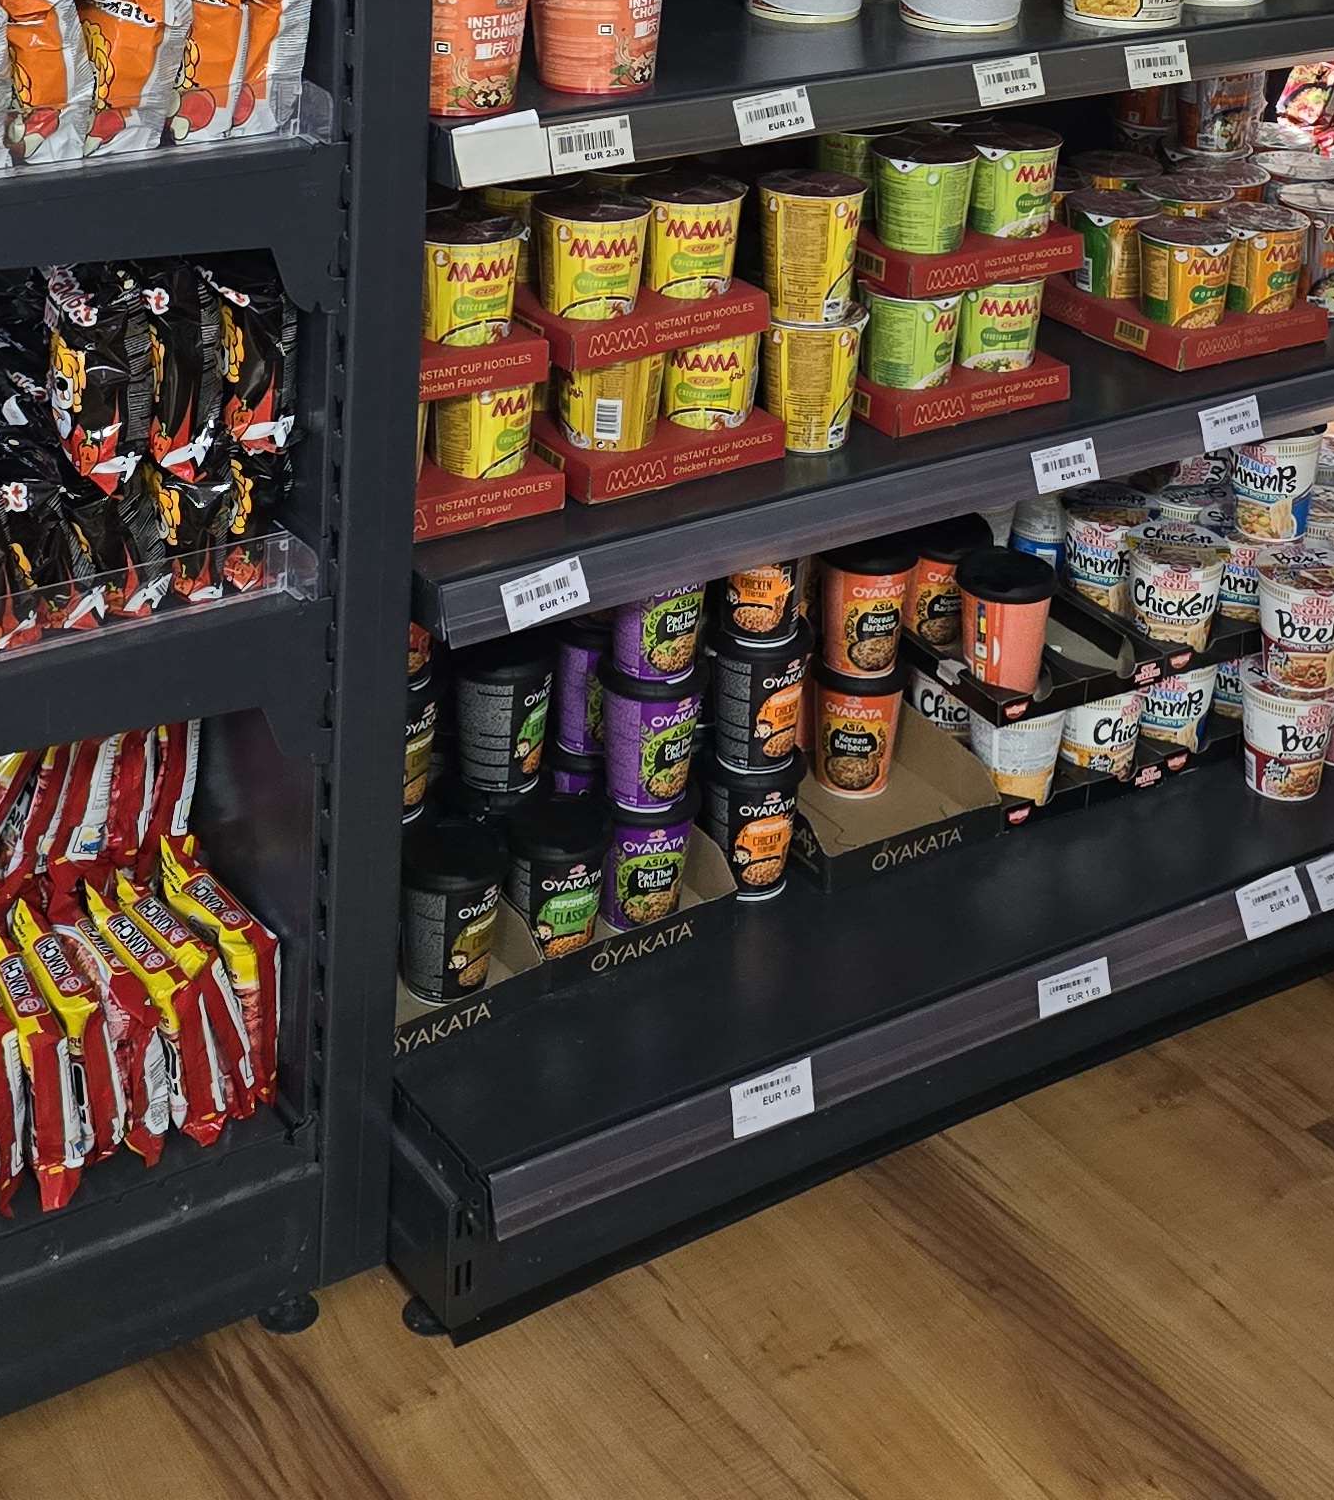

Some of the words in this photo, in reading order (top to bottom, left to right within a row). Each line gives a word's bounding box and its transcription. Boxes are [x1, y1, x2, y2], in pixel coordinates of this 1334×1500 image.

[1152, 72, 1168, 82] EUR
[1169, 68, 1184, 79] 2.79
[1004, 84, 1021, 96] EUR
[1022, 81, 1038, 93] 2.79
[768, 121, 788, 131] EUR
[584, 151, 604, 162] EUR
[606, 147, 626, 159] 2.39
[666, 217, 733, 241] MAMA
[568, 236, 639, 260] MAMA
[926, 261, 978, 291] MAMA
[1017, 251, 1033, 264] CUP
[1033, 244, 1074, 261] NOODLES
[984, 264, 1020, 279] Vegetable
[1022, 258, 1048, 273] Flavour
[587, 324, 650, 359] MAMA
[654, 315, 689, 331] INSTANT
[689, 312, 708, 325] CUP
[710, 302, 755, 322] NOODLES
[654, 328, 684, 344] Chicken
[686, 319, 722, 337] Flavour
[673, 447, 706, 464] INSTANT
[707, 442, 726, 455] CUP
[727, 432, 773, 452] NOODLES
[1060, 471, 1076, 482] EUR
[1079, 466, 1093, 478] 1.79
[435, 499, 476, 514] INSTANT
[479, 492, 499, 506] CUP
[501, 481, 552, 501] NOODLES
[435, 510, 474, 527] Chicken
[477, 502, 512, 519] Flavour
[852, 580, 908, 599] OYAKATA
[1153, 578, 1199, 591] NOODLES
[538, 599, 556, 613] EUR
[559, 590, 579, 607] 1.79
[861, 620, 897, 634] Barbecue
[866, 615, 895, 627] Korean
[825, 705, 883, 720] OYAKATA
[841, 722, 866, 733] ASIA
[833, 740, 873, 753] Barbecue
[836, 734, 869, 745] Korean
[738, 796, 796, 819] OYAKATA
[622, 835, 685, 854] OYAKATA
[752, 832, 783, 846] CHICKEN
[541, 867, 603, 894] OYAKATA
[636, 870, 653, 881] Pad
[654, 867, 673, 880] Thai
[636, 876, 672, 889] Chicken
[1270, 901, 1284, 912] EUR
[137, 896, 177, 942] KIMCHI
[589, 920, 693, 972] OYAKATA
[36, 936, 71, 980] KIMCHI
[2, 955, 30, 999] KIMCHI
[762, 1092, 782, 1106] EUR
